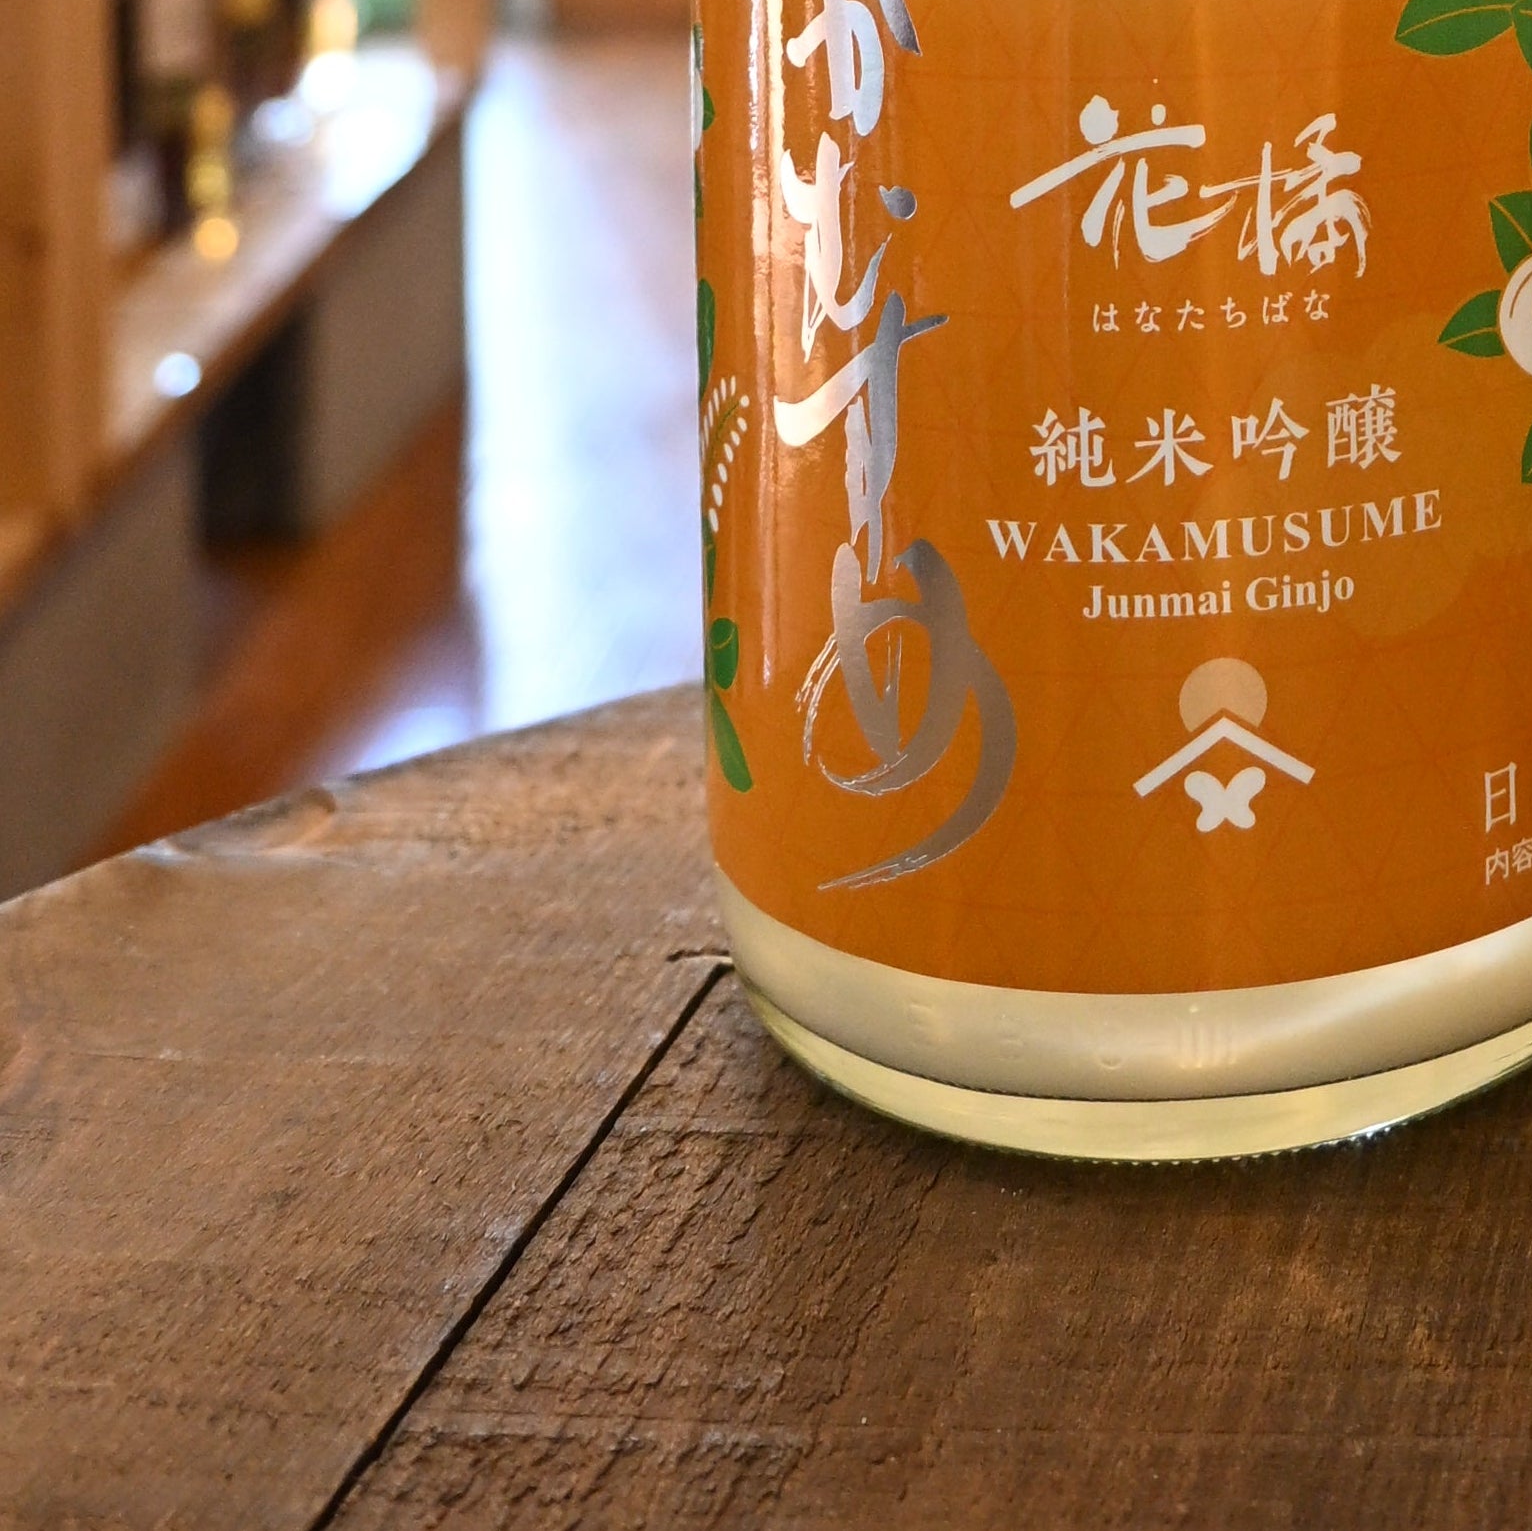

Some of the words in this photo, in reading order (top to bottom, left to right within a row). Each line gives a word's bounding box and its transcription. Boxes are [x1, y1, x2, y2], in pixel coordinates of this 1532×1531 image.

[1091, 289, 1332, 334] はなたちばな
[1028, 383, 1402, 492] 純米吟醸
[985, 488, 1444, 565] WAKAMUSUME
[1081, 583, 1233, 620] Junmai
[1245, 569, 1357, 616] Ginjo
